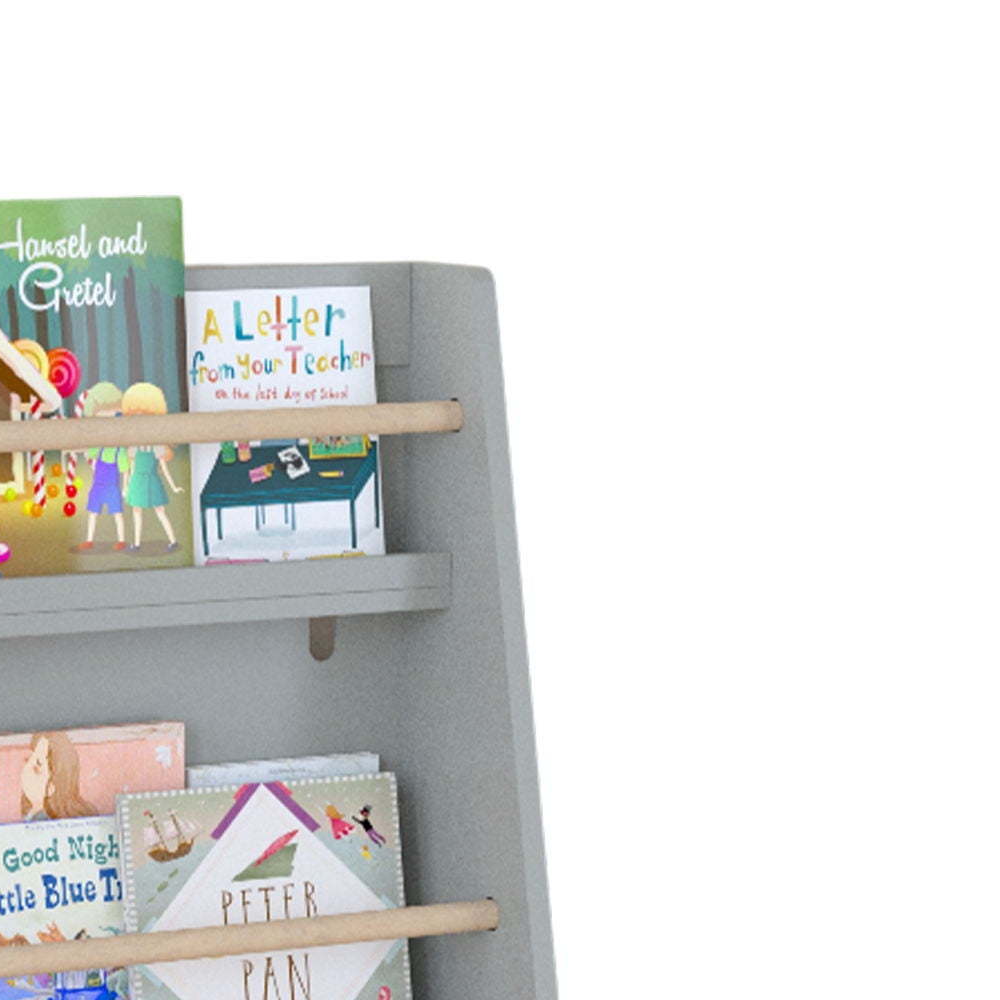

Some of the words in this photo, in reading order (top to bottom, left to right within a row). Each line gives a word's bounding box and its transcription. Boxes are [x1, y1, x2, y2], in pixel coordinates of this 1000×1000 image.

[98, 221, 148, 259] and
[18, 261, 117, 313] Gretel
[202, 308, 224, 345] A
[232, 295, 346, 342] Letter
[189, 351, 235, 386] from
[236, 353, 283, 380] your
[285, 339, 371, 375] Teacher
[2, 838, 60, 873] Good
[67, 834, 120, 865] Nigh
[41, 873, 98, 909] Blue
[221, 880, 319, 926] PETER
